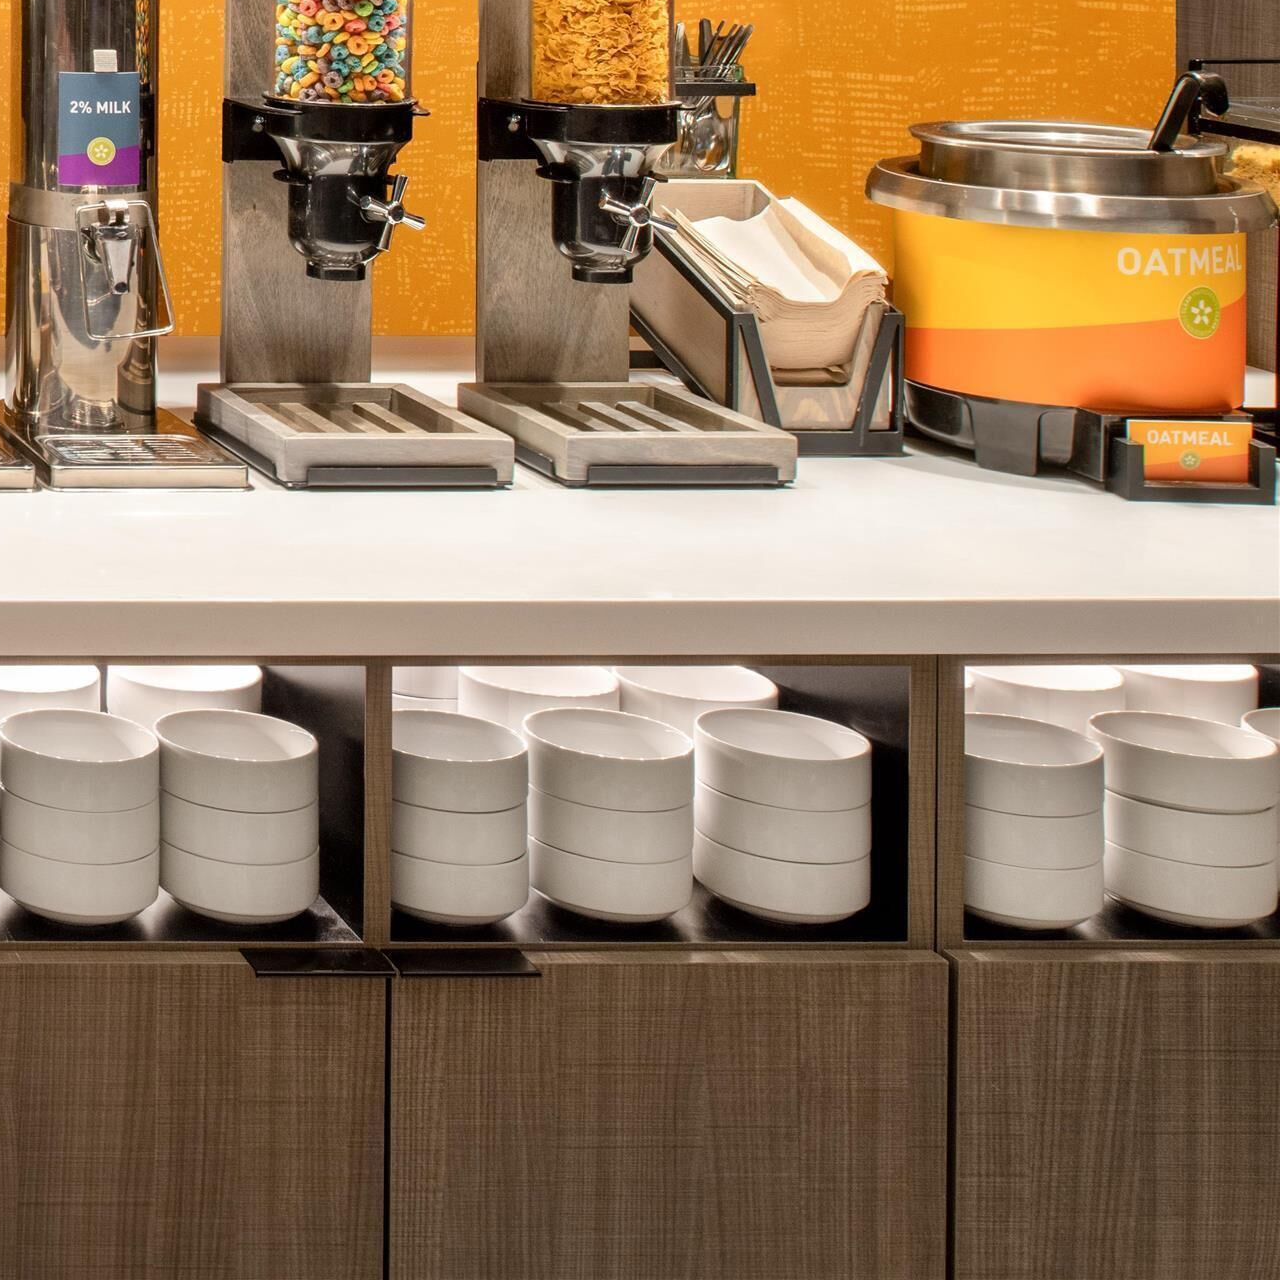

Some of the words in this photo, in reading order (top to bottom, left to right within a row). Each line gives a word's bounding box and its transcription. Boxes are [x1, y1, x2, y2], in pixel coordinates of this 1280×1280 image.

[69, 100, 93, 114] 2%
[96, 100, 132, 114] MILK
[1116, 243, 1243, 276] OATMEAL
[1146, 429, 1233, 446] OATMEAL
